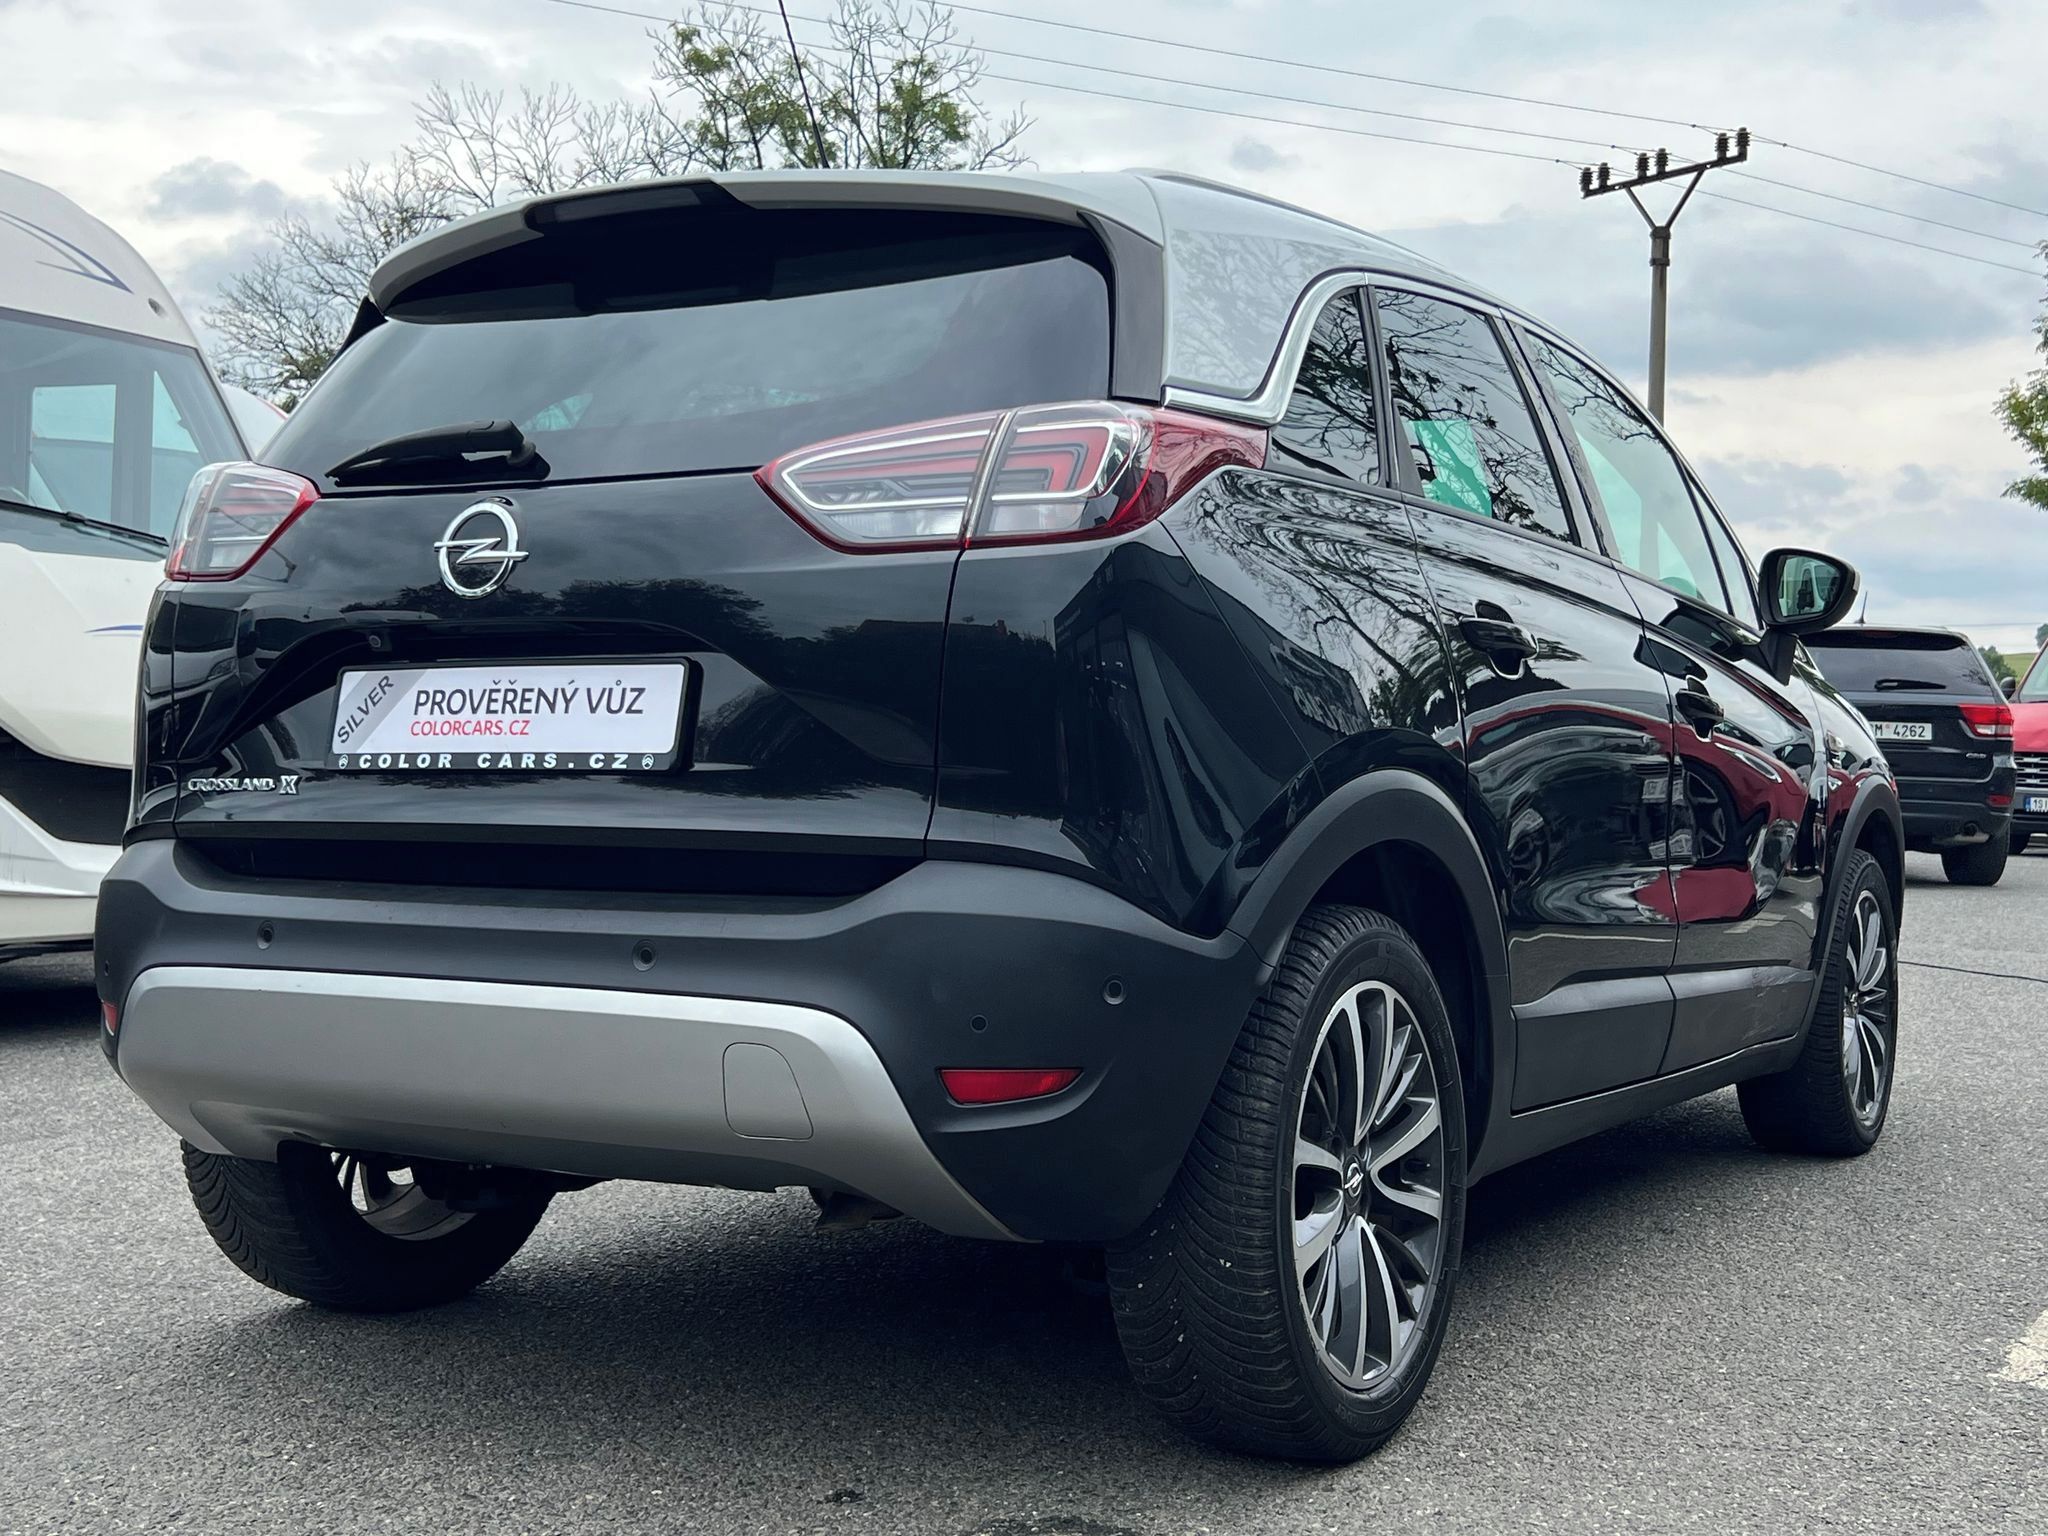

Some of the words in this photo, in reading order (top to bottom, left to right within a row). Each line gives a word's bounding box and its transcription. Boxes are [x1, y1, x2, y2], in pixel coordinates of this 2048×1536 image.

[413, 680, 580, 716] PROVĚŘENÝ
[586, 679, 647, 715] VŮZ
[338, 675, 393, 744] SILVER
[410, 719, 531, 737] COLORCARS.CZ
[1892, 724, 1926, 738] 4262
[359, 753, 453, 769] COLOR
[187, 778, 275, 791] CROSSLAND
[279, 775, 299, 794] X
